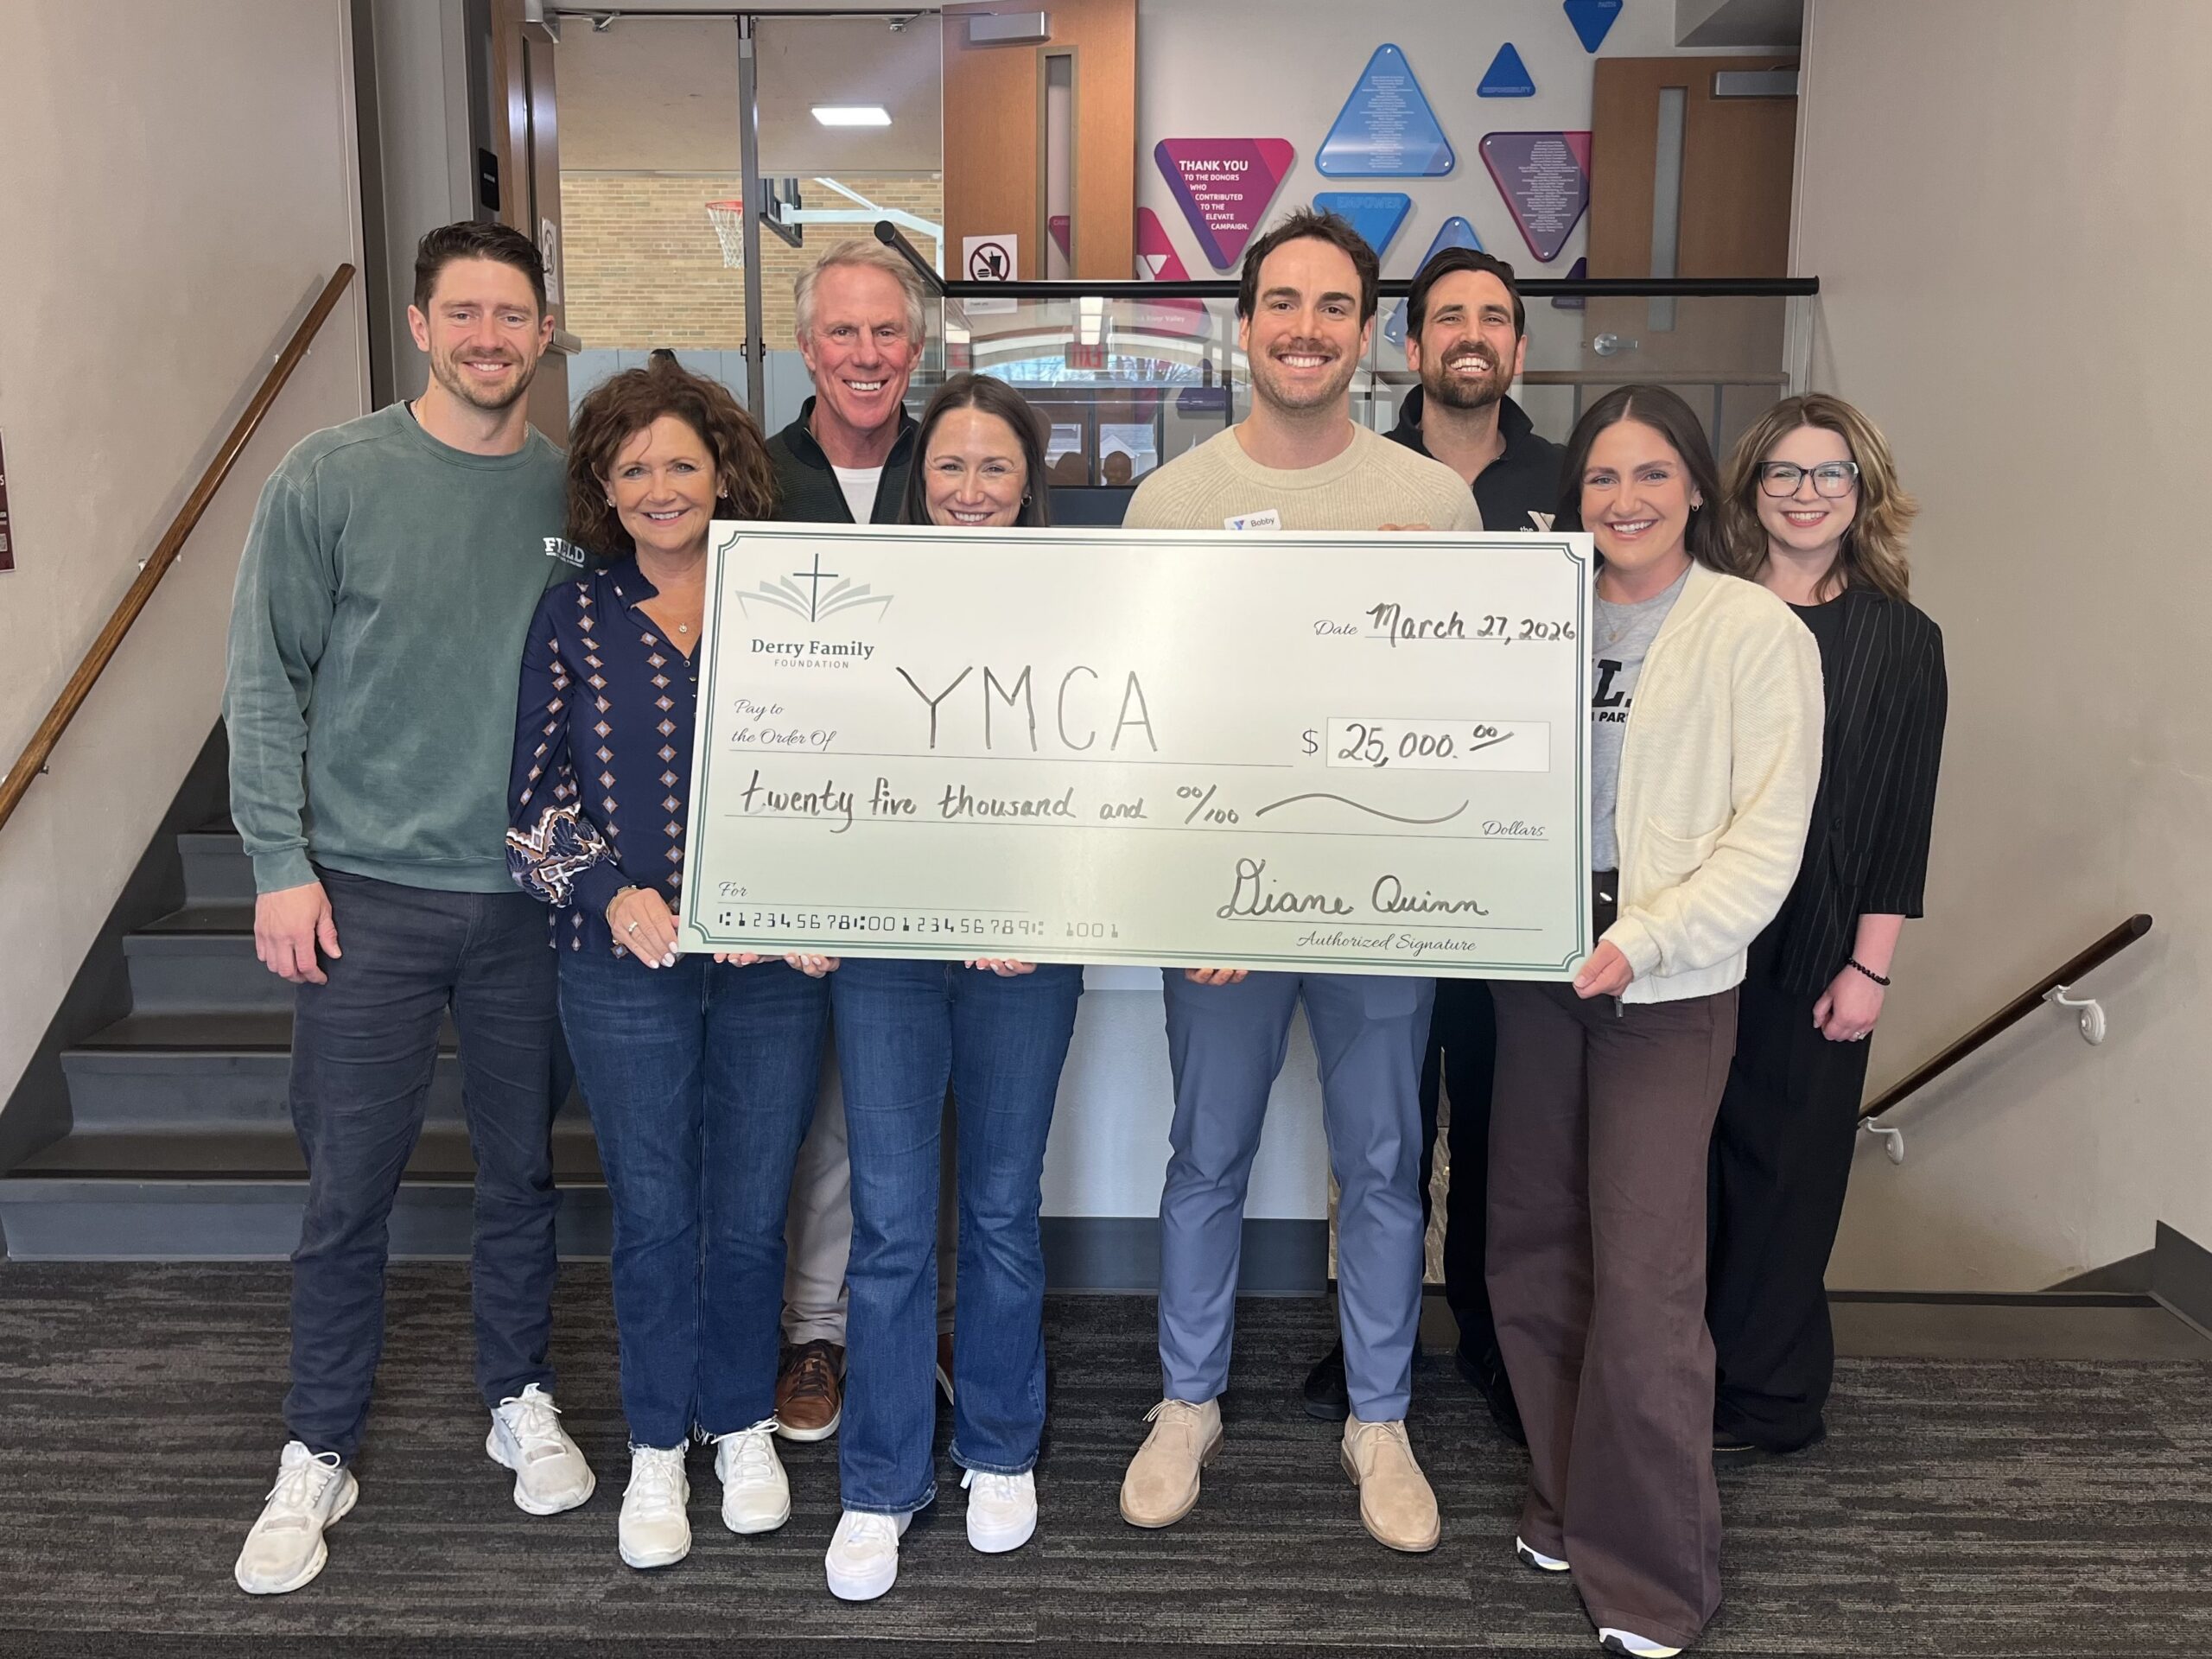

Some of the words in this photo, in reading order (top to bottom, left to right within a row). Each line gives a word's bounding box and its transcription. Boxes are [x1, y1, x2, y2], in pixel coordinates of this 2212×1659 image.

[1179, 160, 1220, 171] THANK
[1223, 160, 1249, 171] YOU
[1250, 518, 1275, 527] Bobby
[1314, 620, 1358, 638] Date
[1366, 602, 1465, 647] March
[1518, 619, 1577, 641] 2026
[751, 639, 804, 658] Derry
[809, 640, 875, 660] Family
[774, 659, 849, 669] FOUNDATION
[734, 699, 766, 721] Pay
[770, 702, 785, 715] to
[895, 664, 1158, 753] YMCA
[1599, 712, 1629, 722] PAR
[732, 729, 757, 744] the
[760, 729, 808, 746] Order
[810, 731, 837, 752] Of
[1301, 728, 1319, 756] $
[741, 770, 855, 834] twenty
[868, 778, 918, 816] five
[938, 784, 1077, 820] thousand
[1100, 797, 1147, 820] and
[1482, 819, 1546, 838] Dollars
[718, 880, 749, 899] For
[1217, 857, 1354, 920] Diane
[1372, 874, 1490, 918] Quinn
[1296, 930, 1395, 950] Authorized
[1395, 931, 1477, 957] Signature
